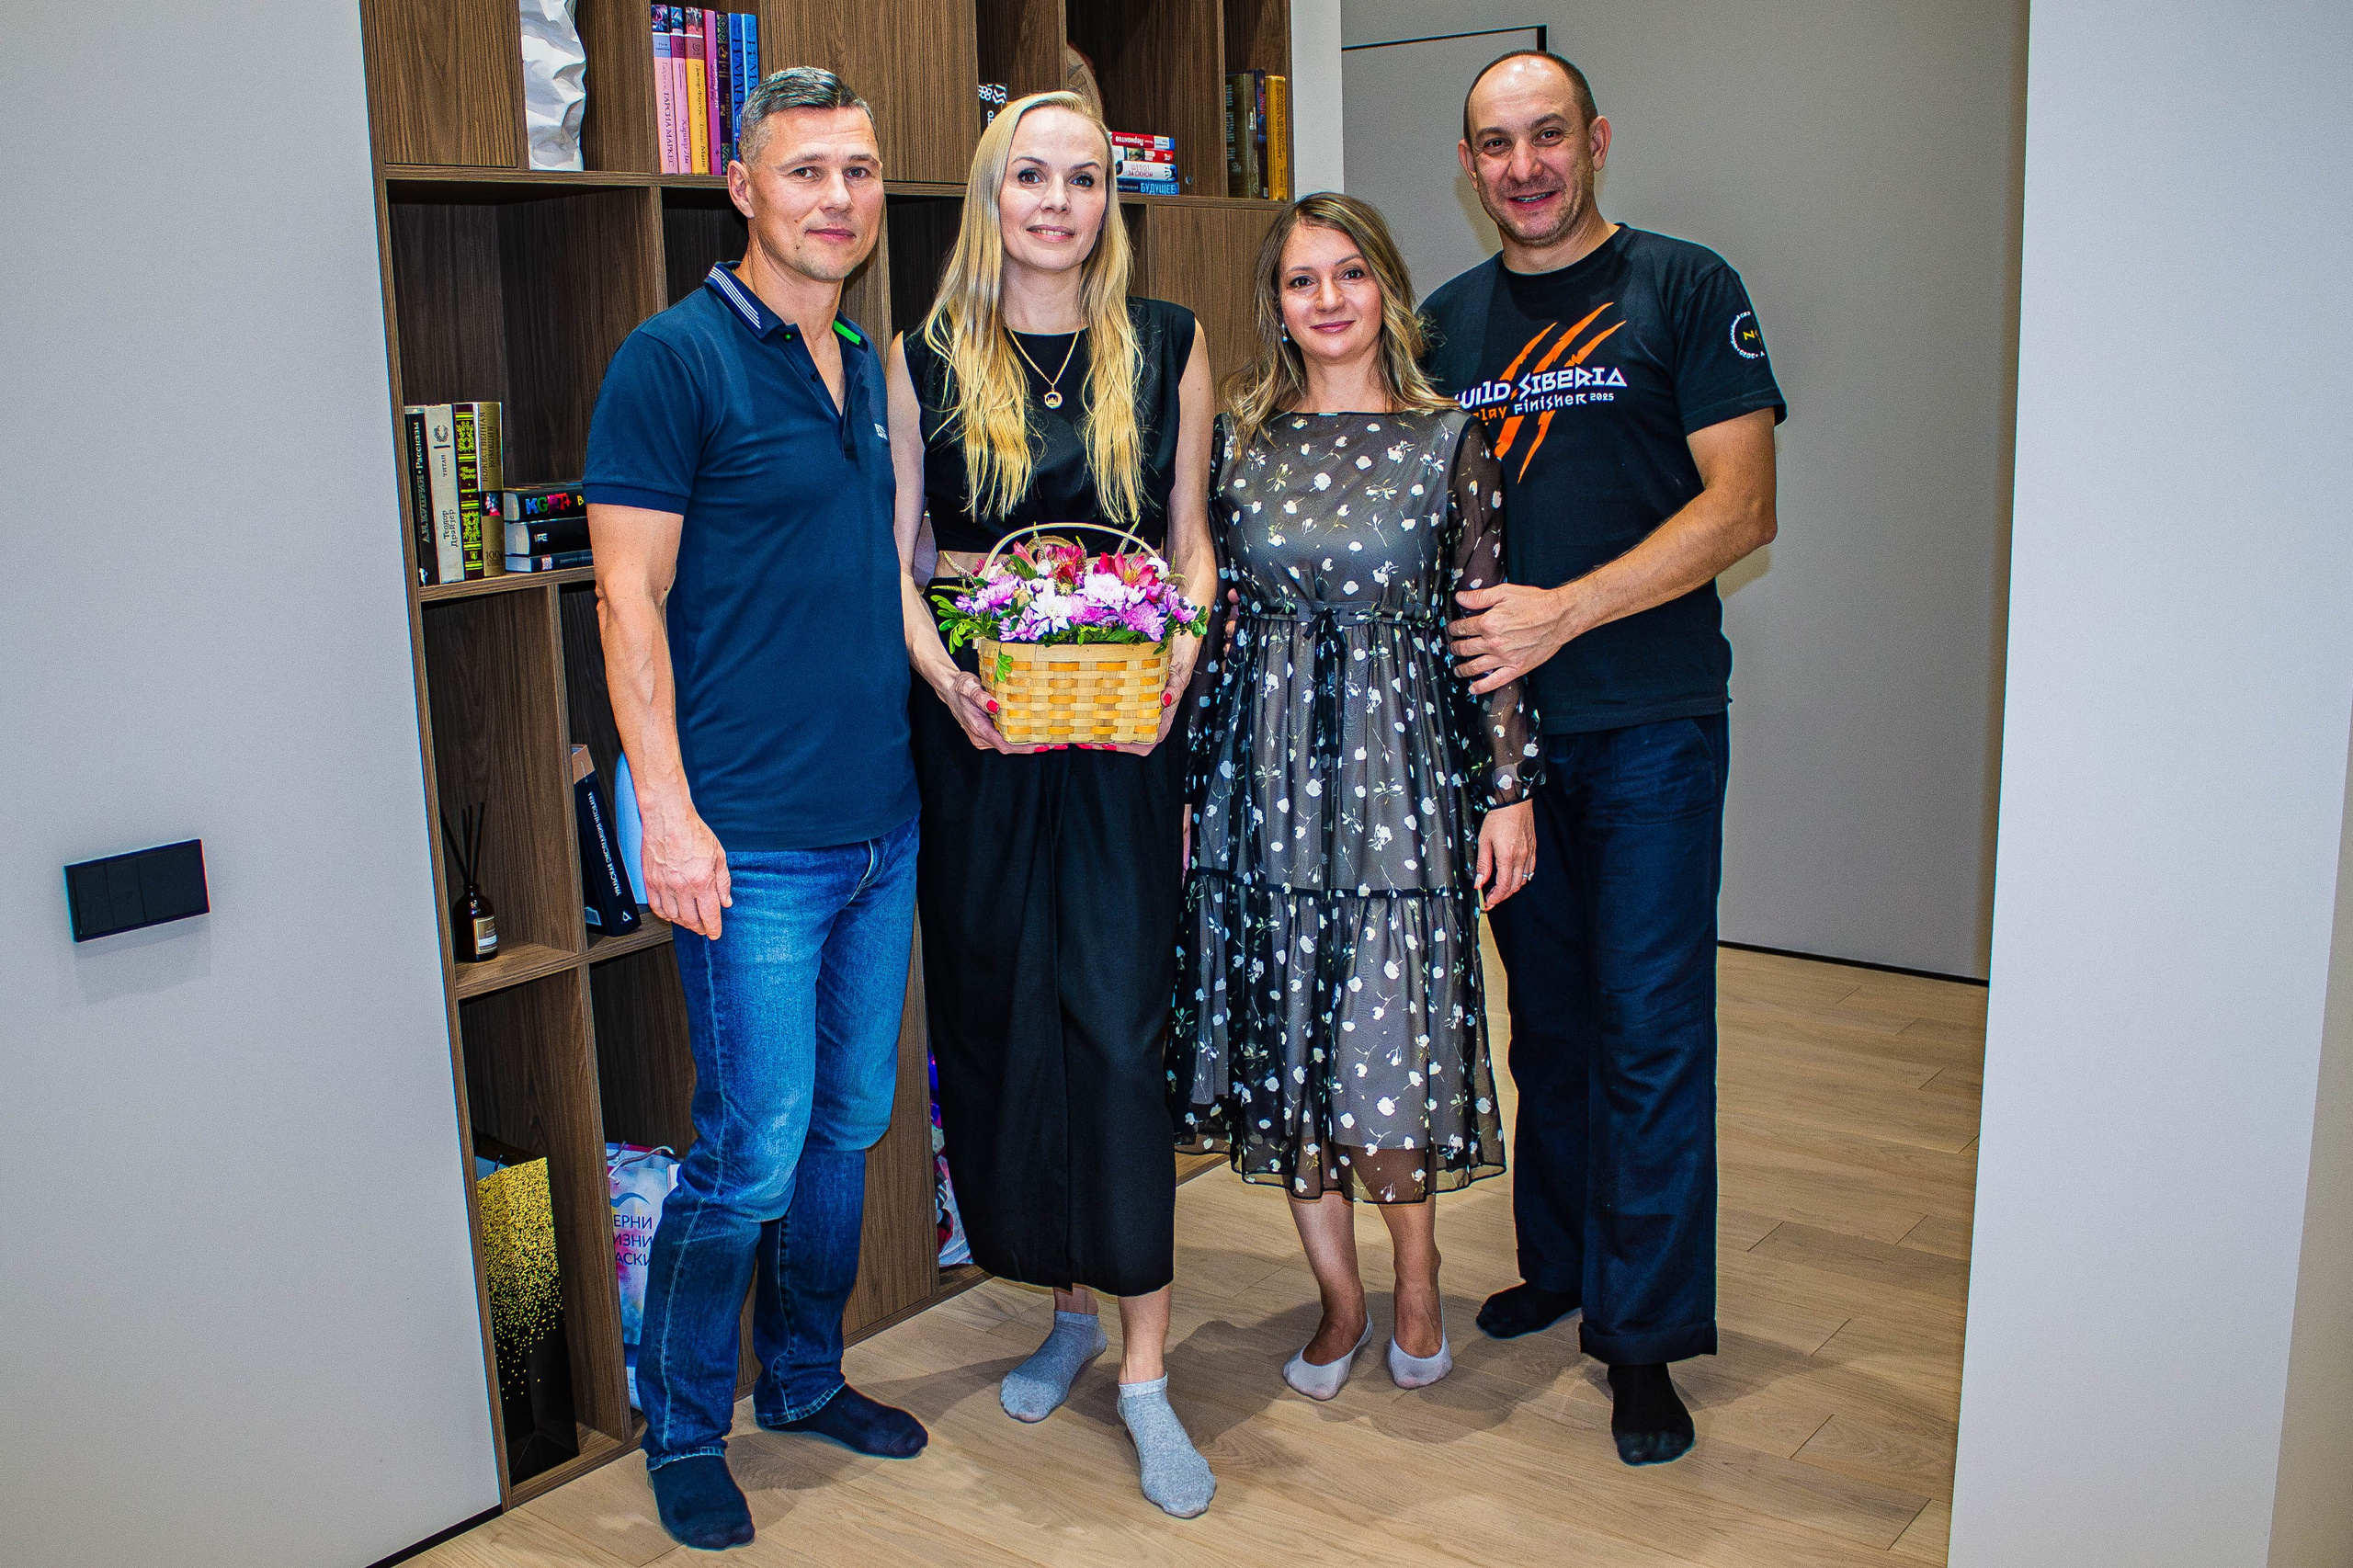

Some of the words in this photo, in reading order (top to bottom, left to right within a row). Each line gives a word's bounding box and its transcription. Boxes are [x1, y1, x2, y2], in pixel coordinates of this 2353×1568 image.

[746, 40, 758, 91] РЕМА
[663, 92, 672, 128] ГАРСИА
[666, 129, 675, 167] МАРКЕС
[1140, 182, 1176, 195] БУДУЩЕЕ
[1518, 367, 1628, 402] SIBERIA
[1472, 405, 1507, 421] lay
[1589, 392, 1614, 402] 2025
[413, 422, 424, 470] Рассказы
[441, 510, 450, 540] Теодор
[449, 509, 459, 548] Драйзер
[613, 1214, 653, 1230] ЕРНИ
[613, 1233, 653, 1248] ИЗНИ
[615, 1252, 651, 1267] АСКИ
